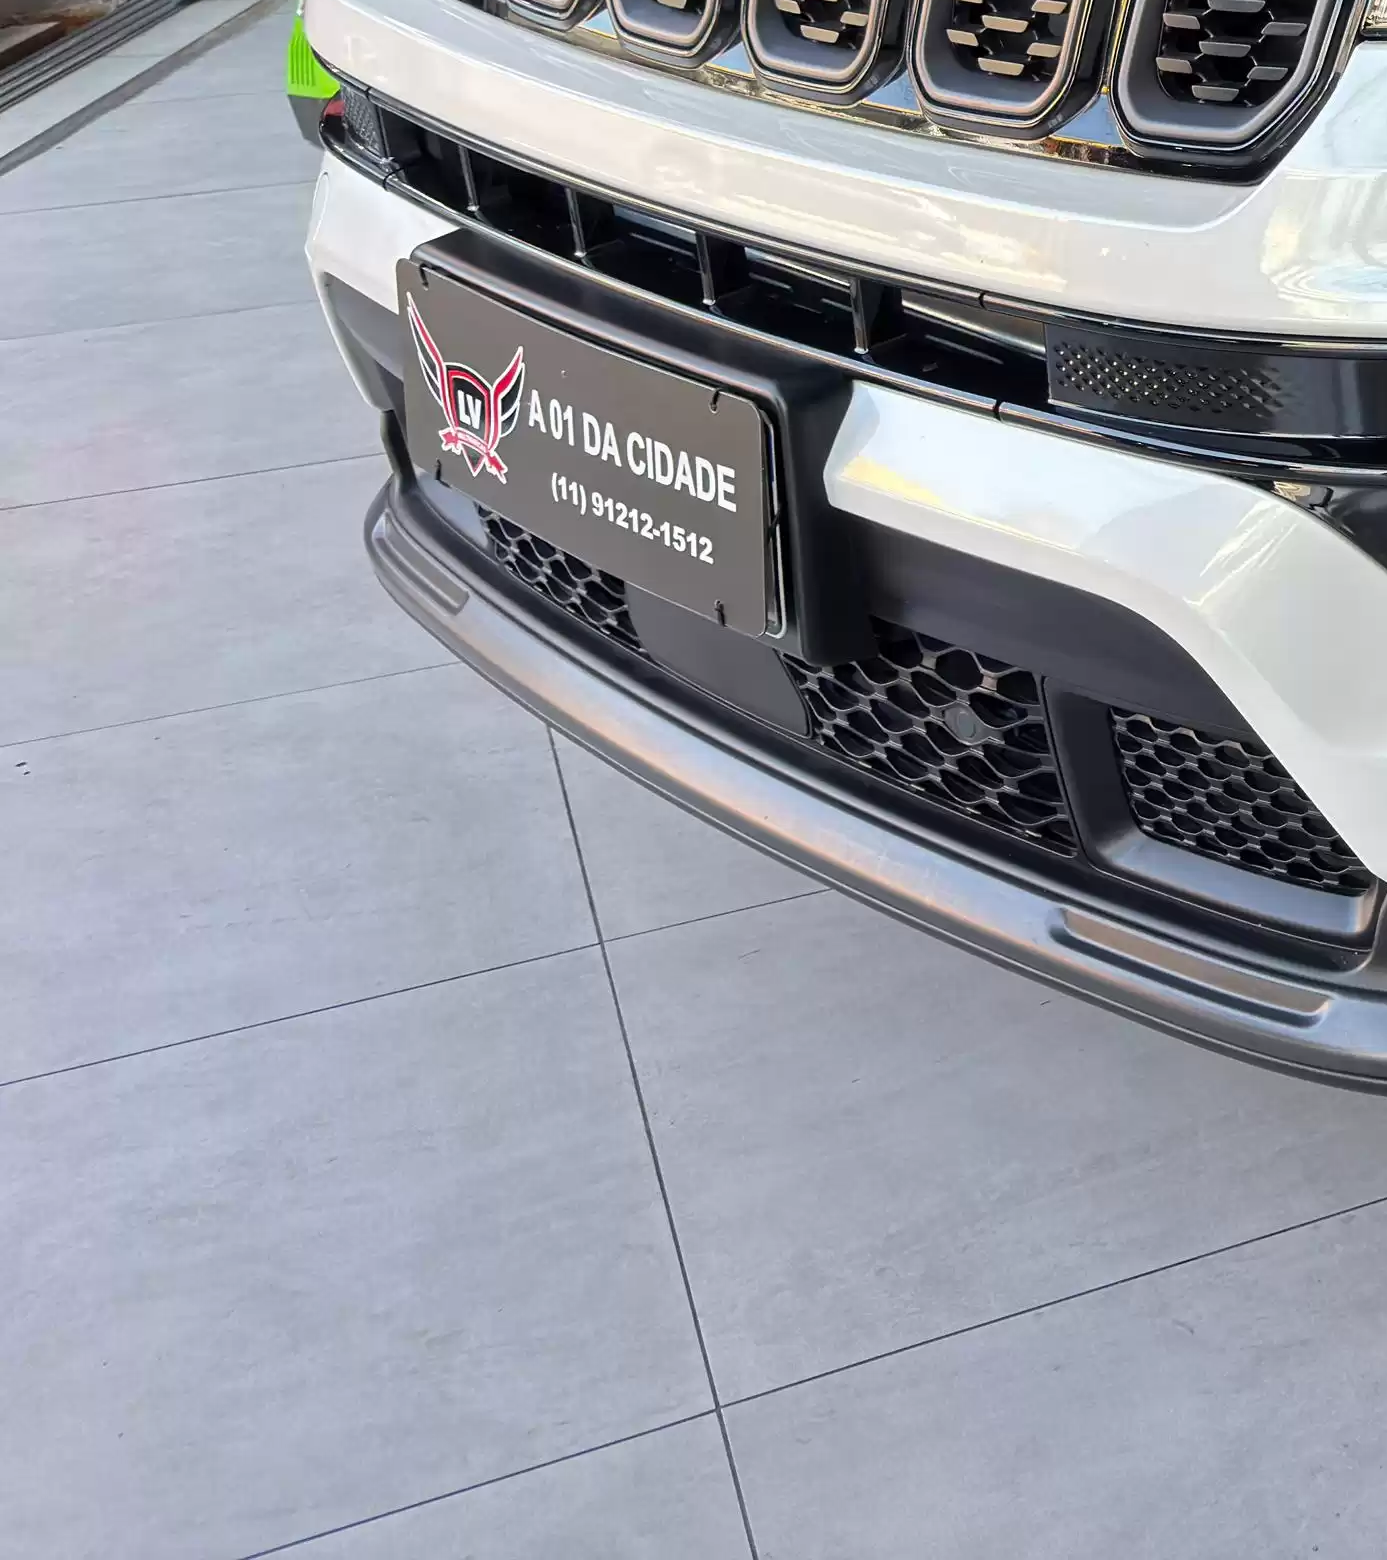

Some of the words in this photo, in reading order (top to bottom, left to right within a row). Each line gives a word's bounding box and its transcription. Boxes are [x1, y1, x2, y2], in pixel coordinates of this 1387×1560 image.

[457, 389, 482, 430] LV
[528, 389, 548, 433] A
[549, 399, 575, 446] 01
[583, 413, 621, 469] DA
[626, 430, 737, 513] CIDADE
[550, 471, 587, 516] (11)
[591, 491, 715, 565] 91212-1512
